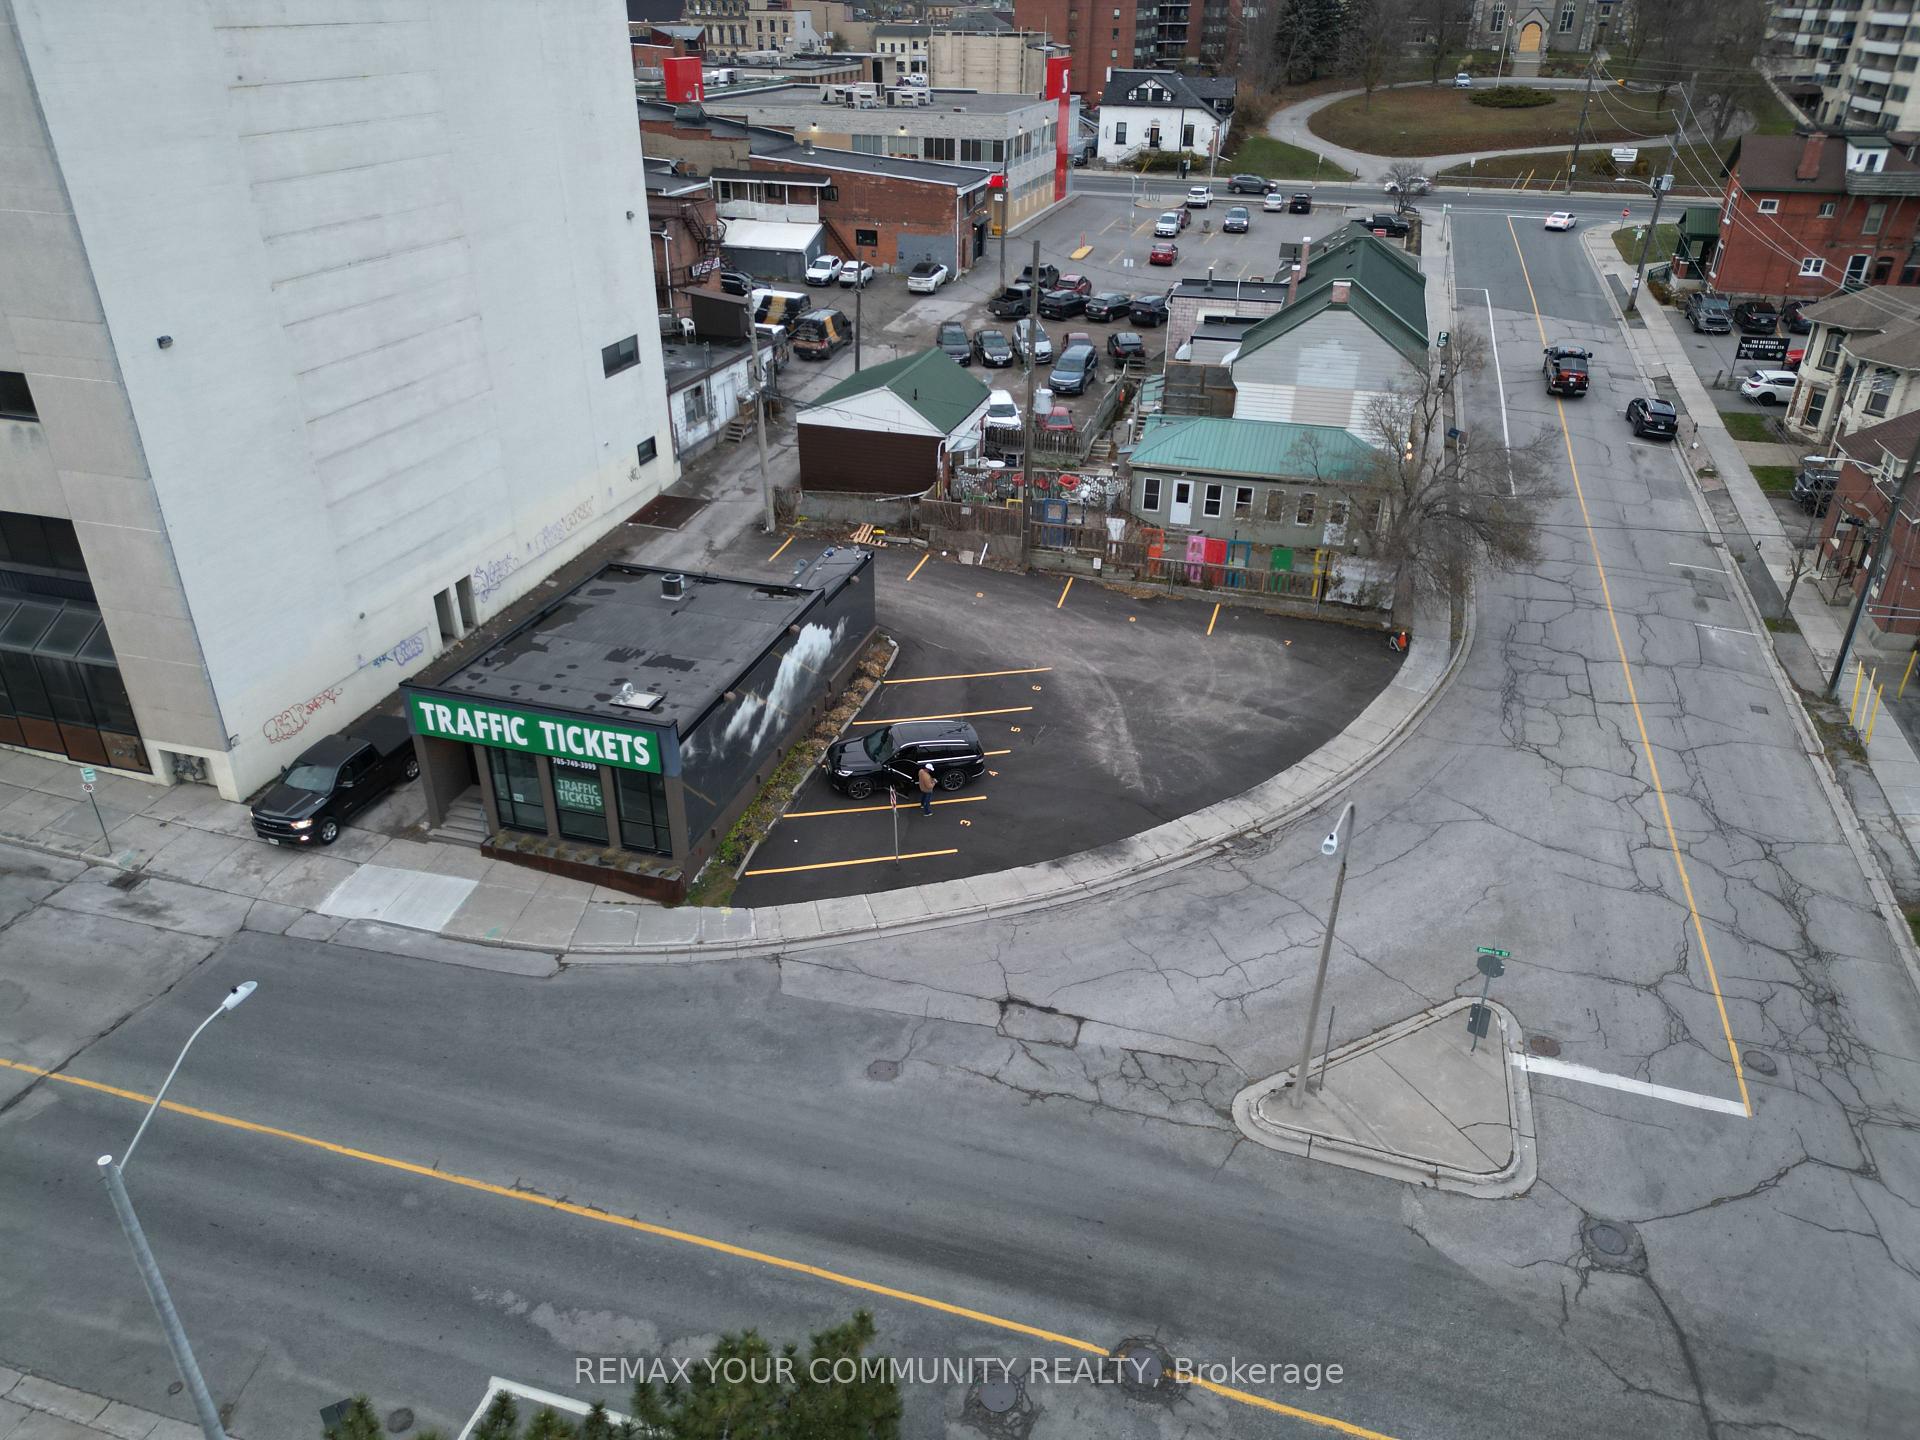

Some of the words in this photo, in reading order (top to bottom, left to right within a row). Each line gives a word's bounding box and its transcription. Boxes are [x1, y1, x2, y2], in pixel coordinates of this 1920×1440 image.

[418, 702, 528, 746] TRAFFIC
[539, 721, 650, 766] TICKETS
[558, 779, 598, 795] TRAFFIC
[558, 790, 602, 806] TICKETS
[960, 819, 971, 827] 3
